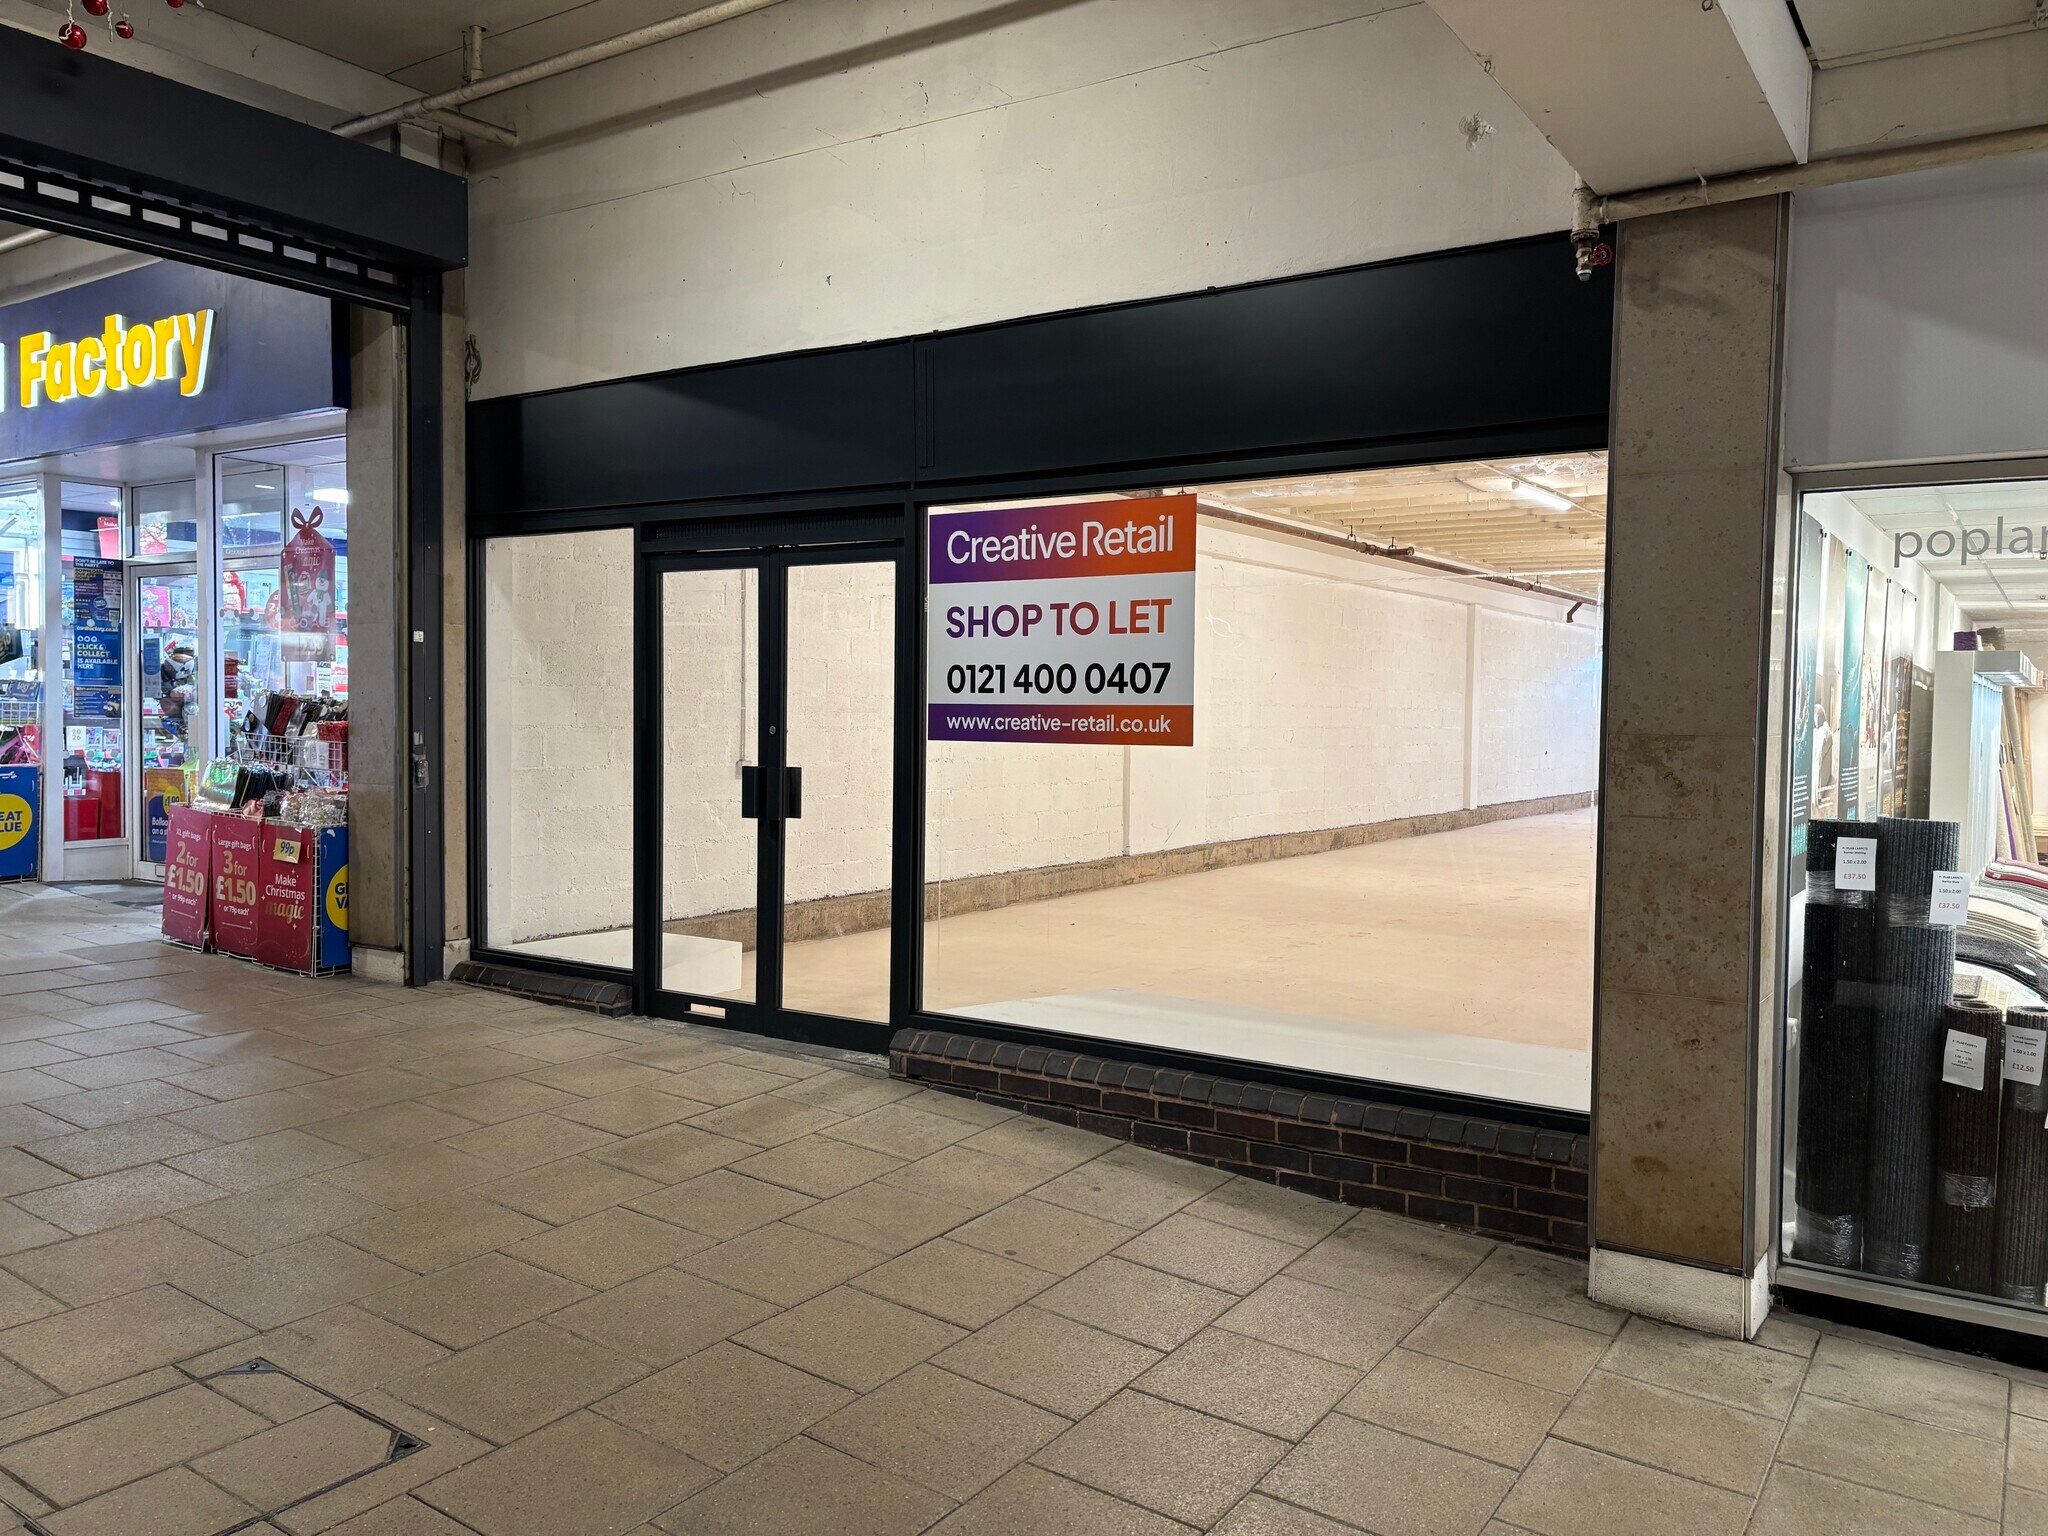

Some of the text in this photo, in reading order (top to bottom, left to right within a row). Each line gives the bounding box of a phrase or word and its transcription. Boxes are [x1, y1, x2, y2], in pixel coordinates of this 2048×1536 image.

[20, 309, 214, 408] Factory
[301, 538, 314, 546] Make
[947, 515, 1174, 565] Creative Retail
[301, 556, 320, 570] agic
[945, 604, 1043, 639] SHOP
[1049, 602, 1099, 637] TO
[1108, 598, 1173, 635] LET
[77, 650, 111, 658] COLLECT
[947, 662, 1171, 694] 0121 400 0407
[947, 713, 1172, 733] www.creative-retail.co.uk
[176, 828, 201, 842] XL gift bags
[218, 838, 251, 852] Large gift bags
[280, 841, 295, 856] 99p
[176, 841, 199, 867] 2 for
[223, 850, 247, 877] 3 for
[167, 864, 204, 896] £1.50
[275, 873, 297, 887] Make
[216, 875, 256, 906] £1.50
[265, 884, 305, 901] Christmas
[177, 894, 185, 905] 99p
[229, 905, 238, 916] 79p
[265, 900, 305, 924] magic
[2012, 1062, 2034, 1073] £12.50
